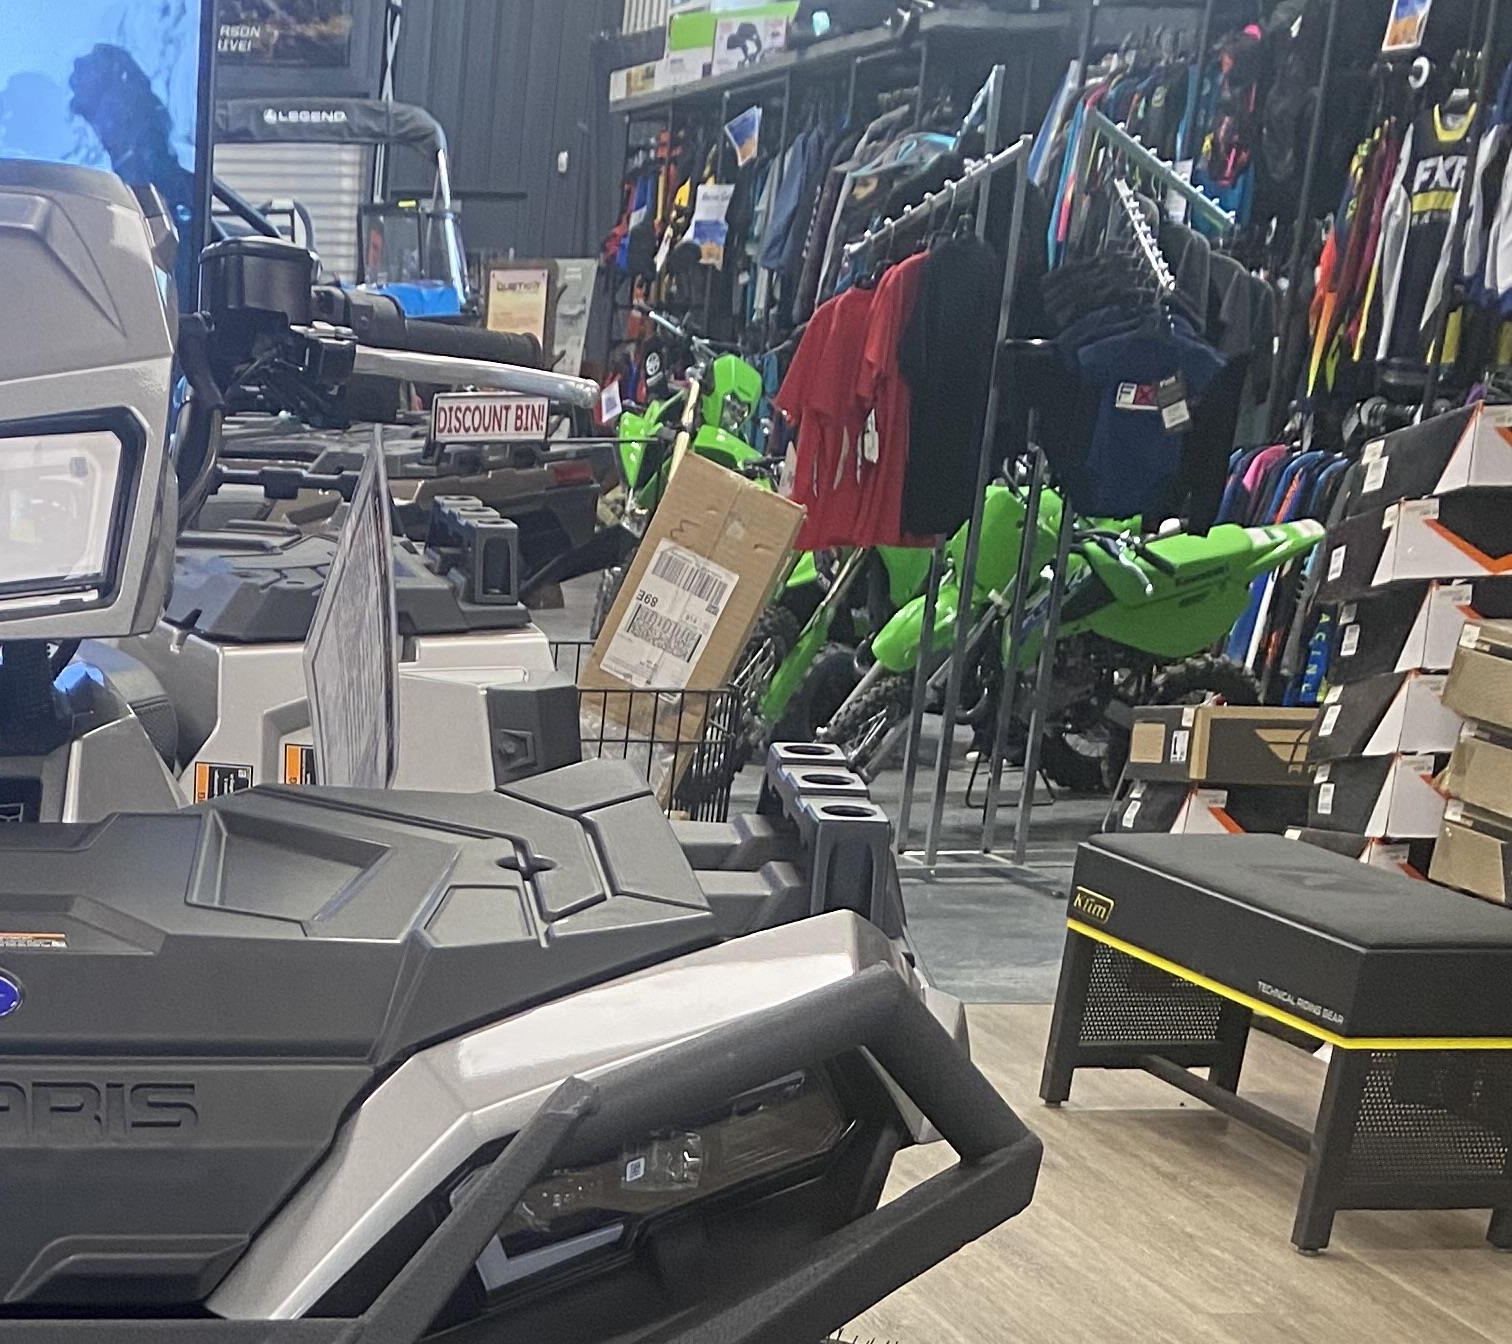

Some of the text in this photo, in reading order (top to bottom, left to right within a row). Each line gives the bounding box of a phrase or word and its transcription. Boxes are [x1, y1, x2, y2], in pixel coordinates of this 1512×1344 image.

[278, 110, 348, 122] LEGEND
[438, 403, 544, 434] DISCOUNT BIN!
[637, 588, 659, 607] 89E
[1257, 981, 1344, 1025] TECHNICAL RIDING GEAR
